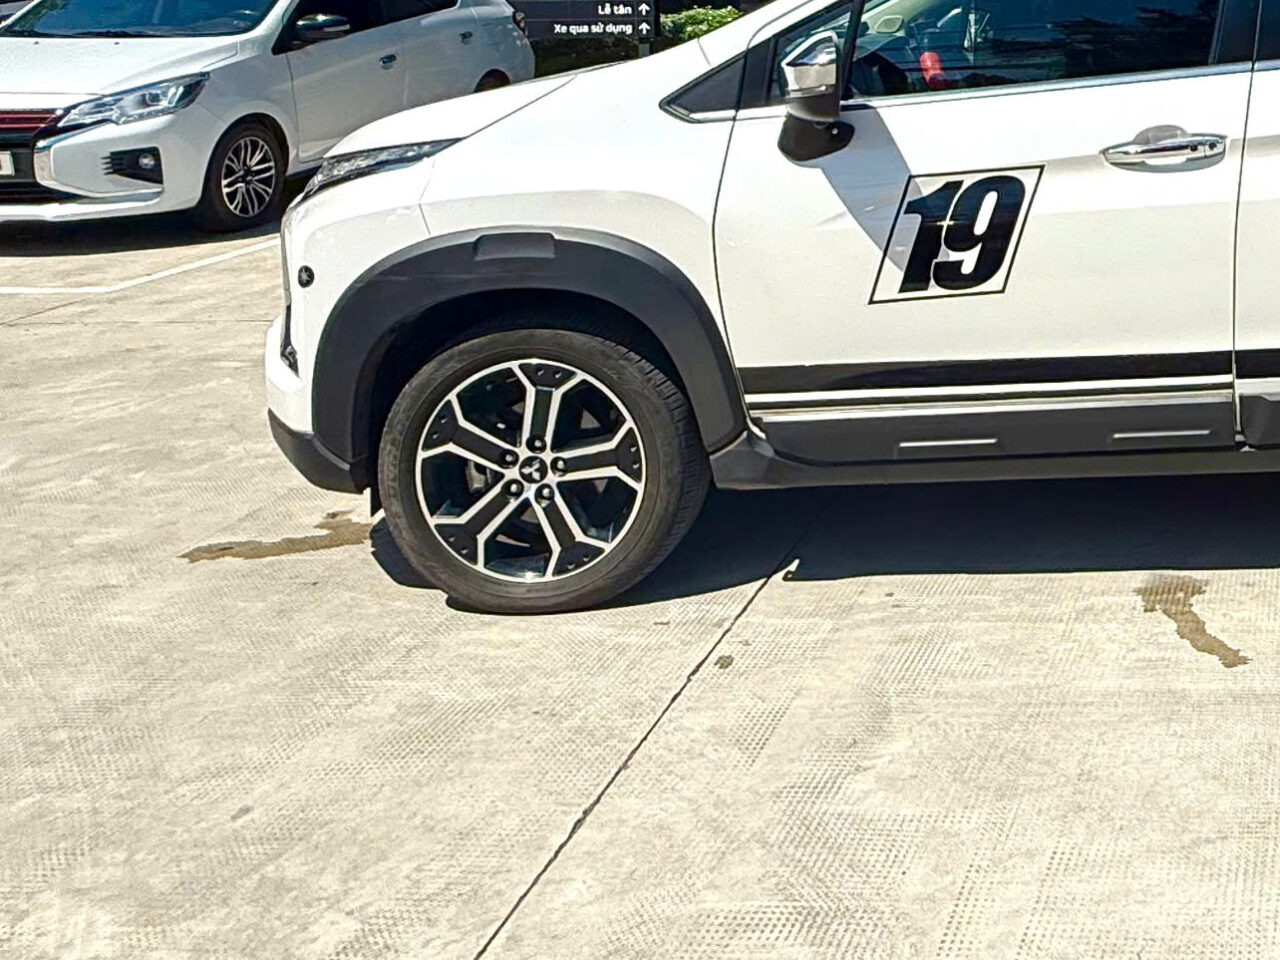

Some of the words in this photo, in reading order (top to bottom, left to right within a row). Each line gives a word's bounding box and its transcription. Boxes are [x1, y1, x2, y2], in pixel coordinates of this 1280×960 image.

[613, 4, 632, 15] tân
[554, 24, 567, 34] Xe
[569, 25, 589, 35] qua
[605, 24, 632, 35] dụng
[898, 175, 1026, 294] 19
